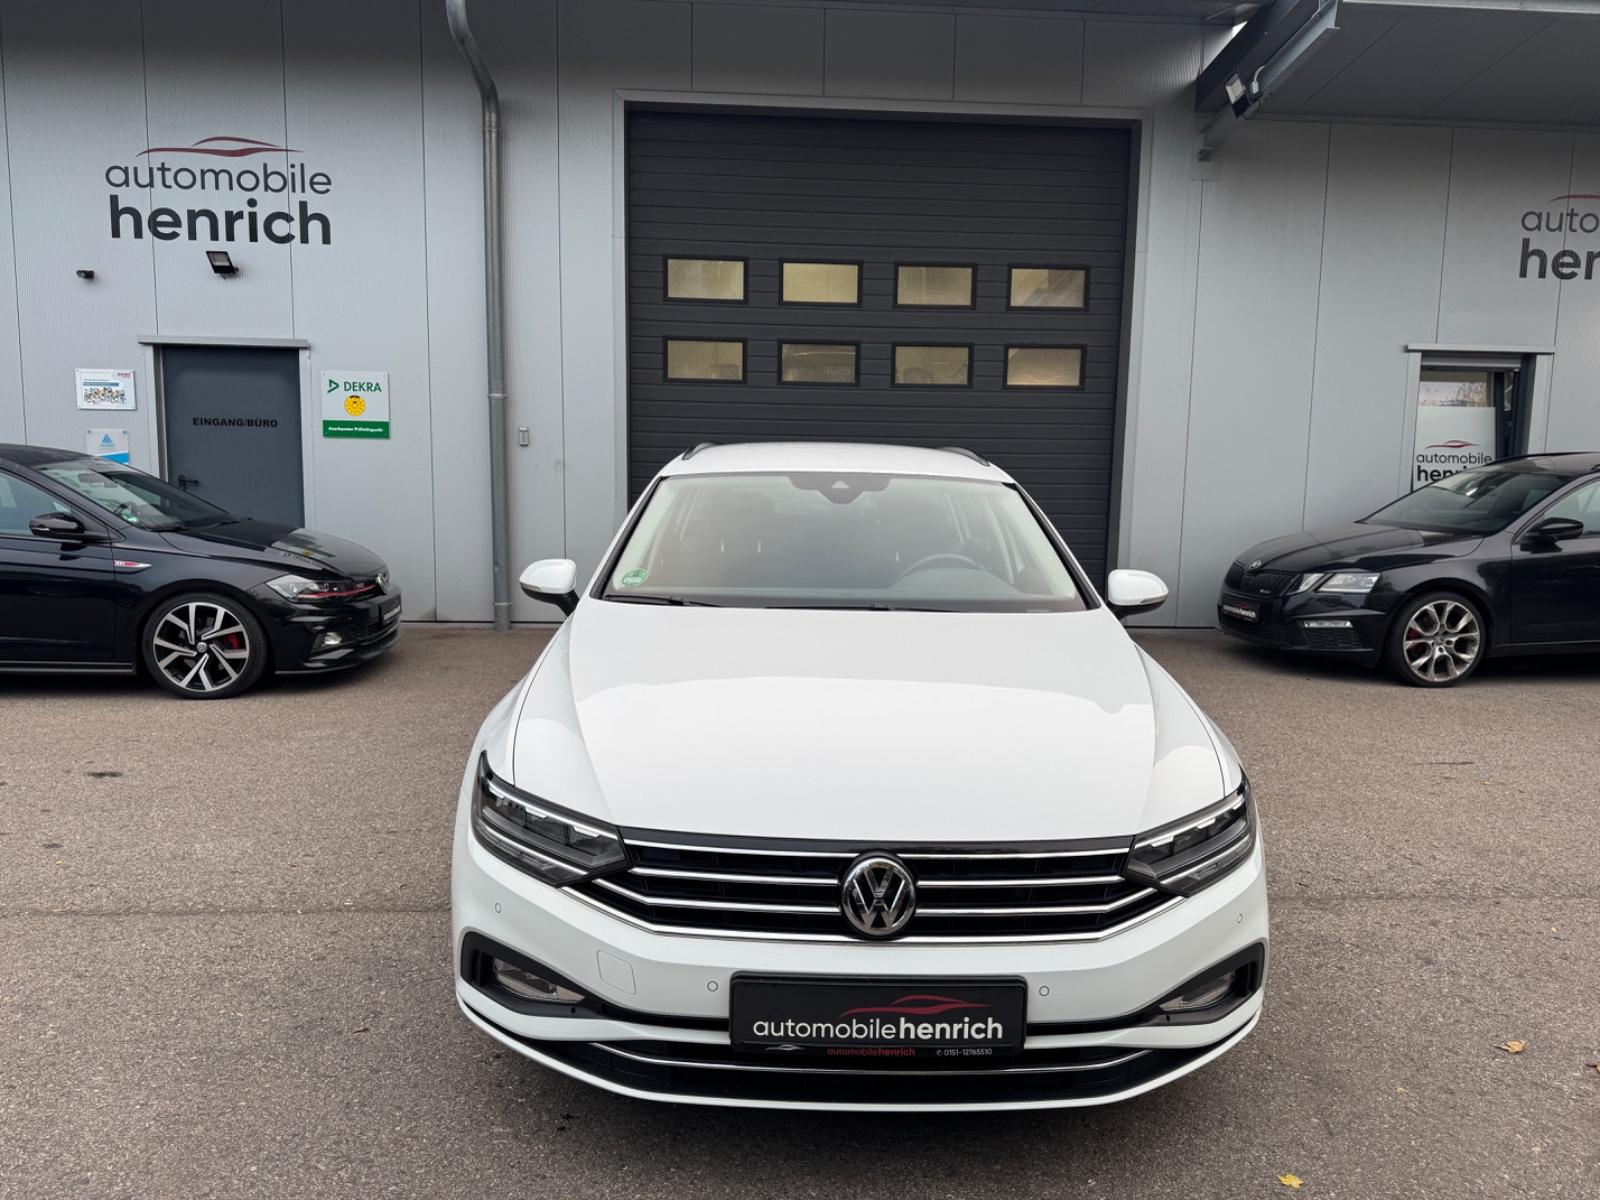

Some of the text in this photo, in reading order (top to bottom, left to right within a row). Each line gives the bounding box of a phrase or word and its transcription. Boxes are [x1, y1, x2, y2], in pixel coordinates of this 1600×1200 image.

[105, 162, 332, 195] automobile
[109, 194, 331, 245] henrich
[343, 381, 382, 392] DEKRA
[192, 416, 279, 428] EINGANG/BÜRO
[1416, 452, 1492, 464] automobile
